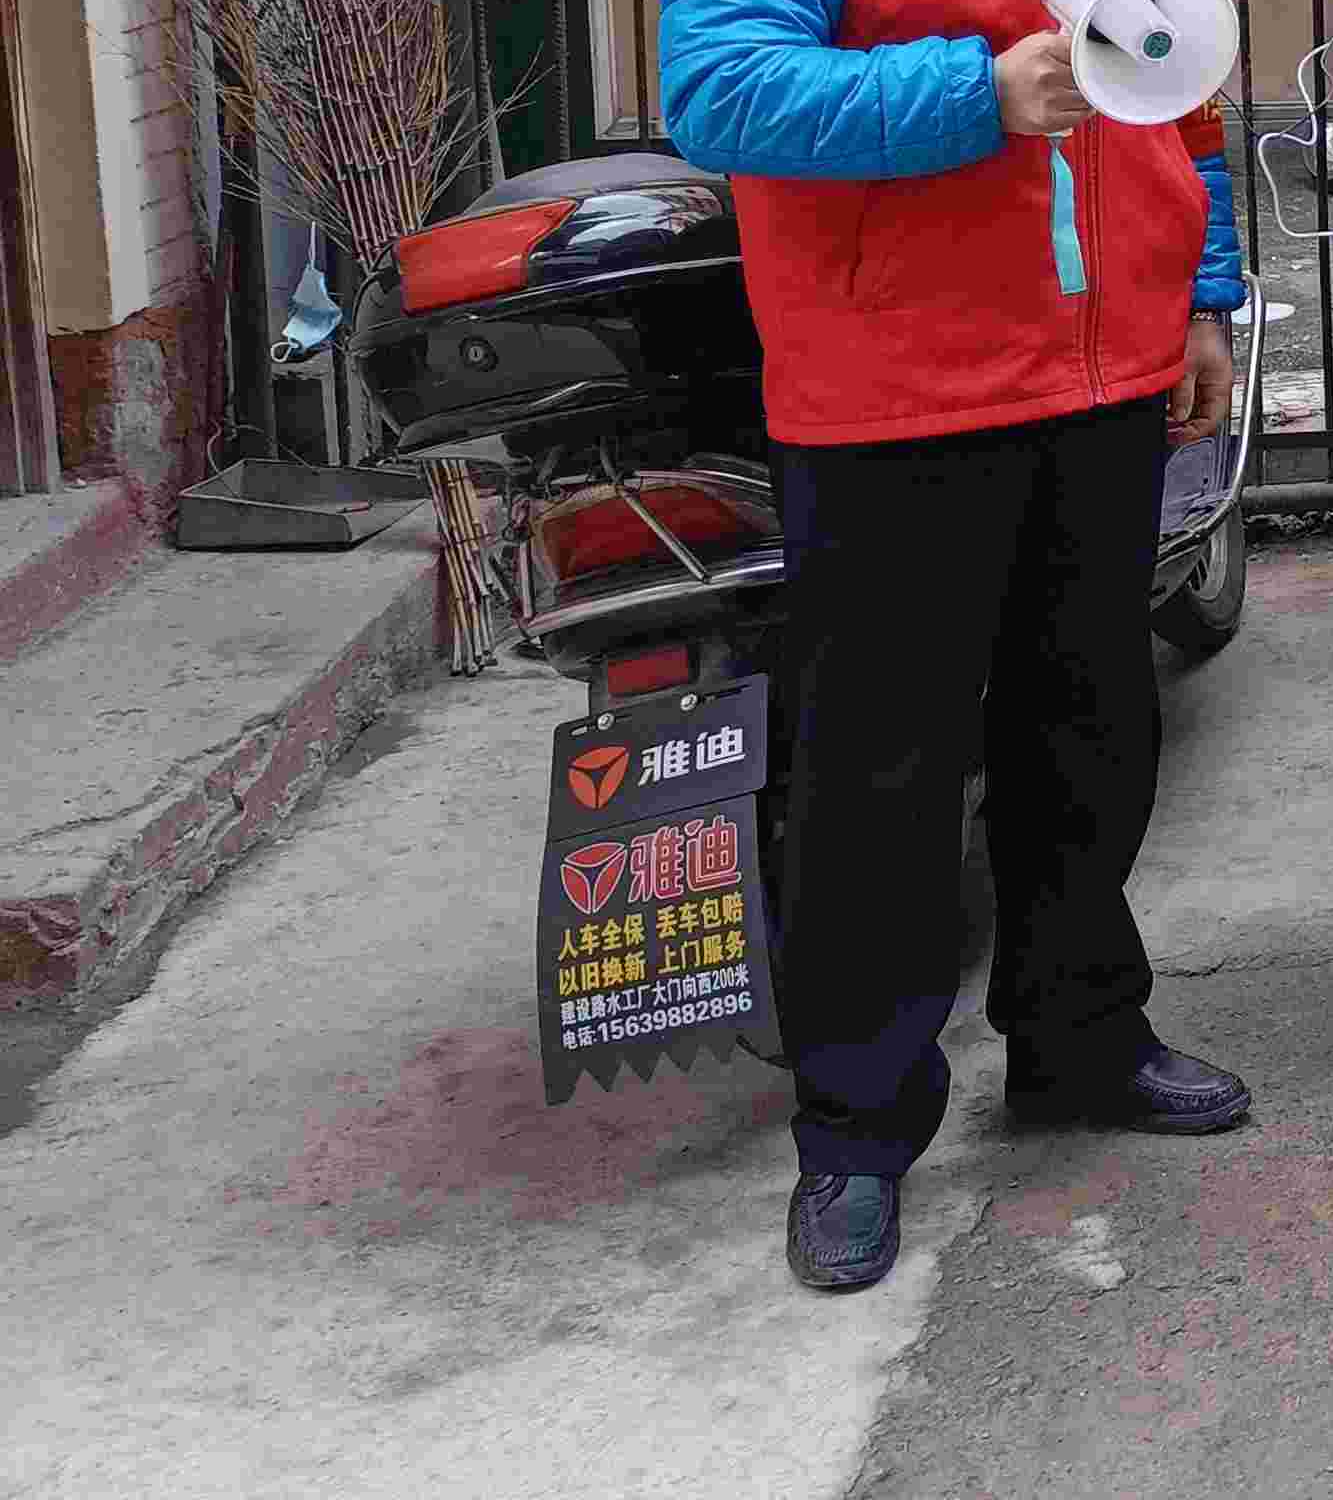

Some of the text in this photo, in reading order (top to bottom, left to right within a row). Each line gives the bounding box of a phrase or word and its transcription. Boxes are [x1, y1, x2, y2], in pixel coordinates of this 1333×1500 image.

[638, 726, 746, 786] 雅迪
[627, 814, 742, 903] 雅迪
[558, 891, 744, 961] 人车全保 丢车包赔
[559, 930, 746, 997] 以旧换新 上门服务
